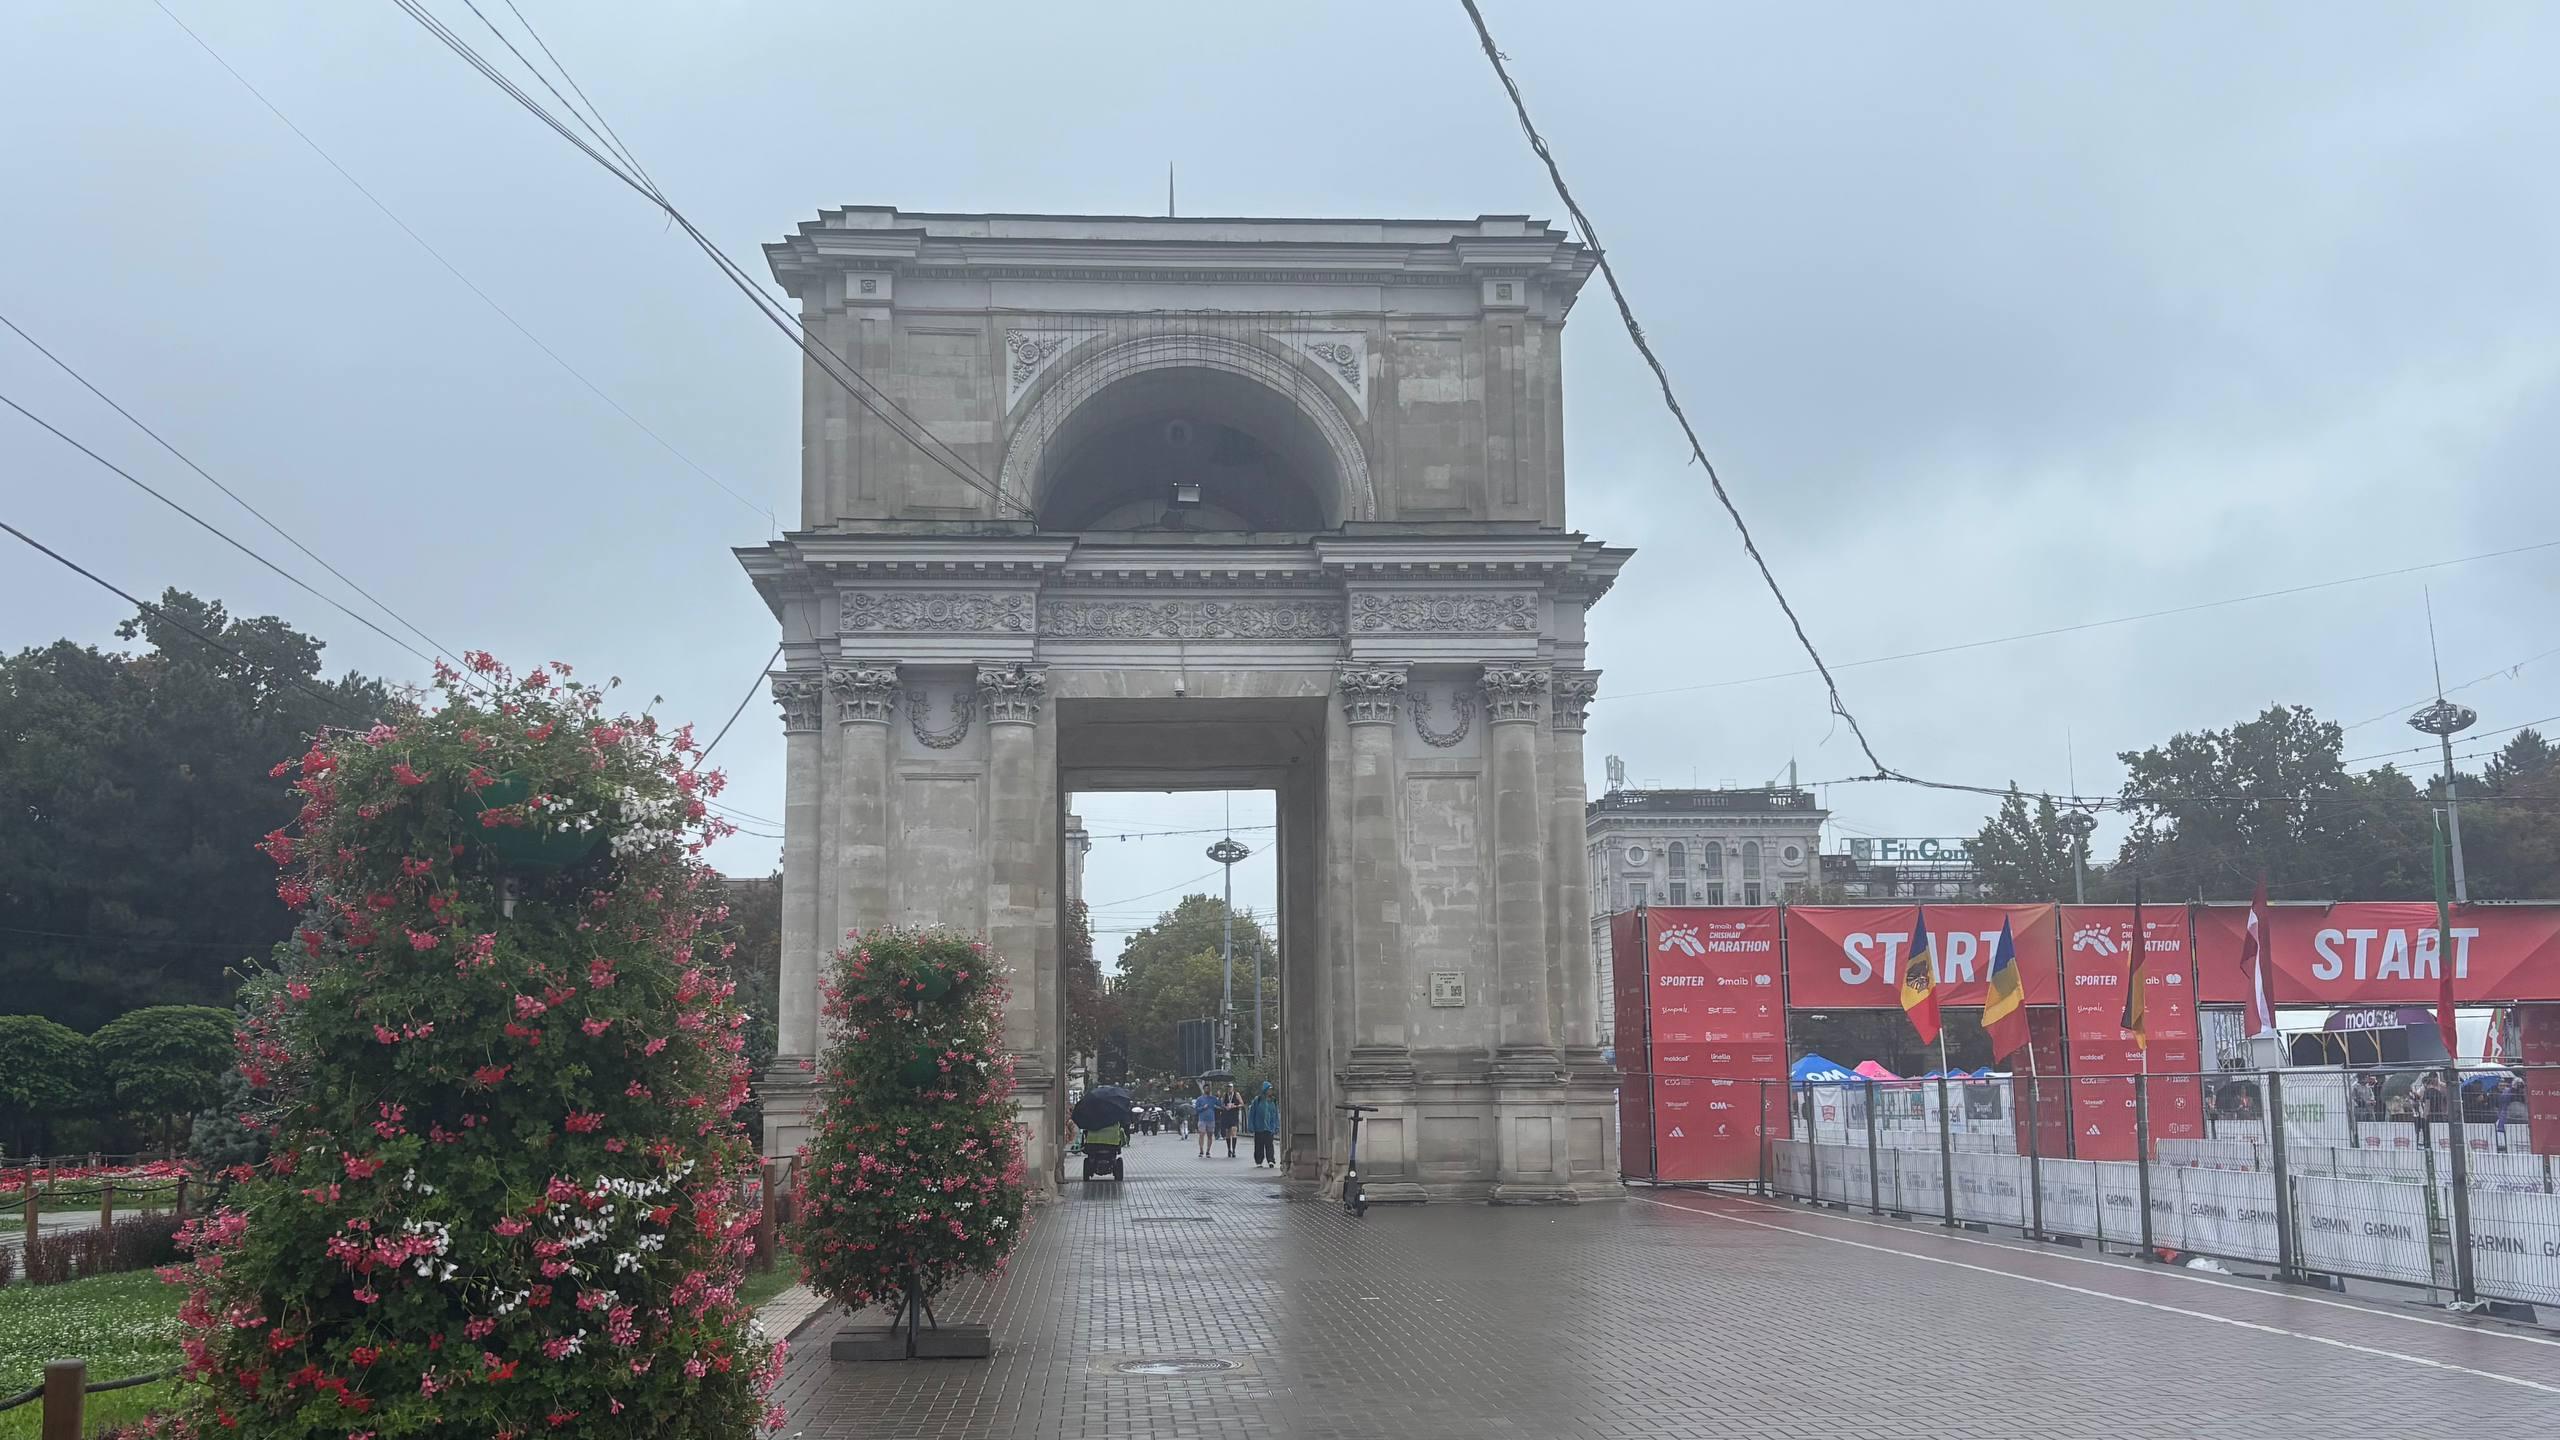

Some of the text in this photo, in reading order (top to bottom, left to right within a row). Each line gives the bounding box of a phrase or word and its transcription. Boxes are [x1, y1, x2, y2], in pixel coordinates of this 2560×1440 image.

[1708, 940, 1770, 952] MARATHON
[2120, 940, 2180, 952] MATHON
[2311, 927, 2479, 981] START
[1660, 975, 1705, 987] SPORTER
[1725, 976, 1749, 986] maib
[2075, 975, 2118, 986] SPORTER
[2145, 976, 2160, 985] aib
[1806, 1069, 1849, 1081] OM
[1709, 1101, 1728, 1110] OM
[2151, 1199, 2173, 1213] RMIN
[2190, 1203, 2228, 1219] GARMIN
[2237, 1208, 2279, 1225] GARMIN
[2311, 1215, 2350, 1233] GARMIN
[2364, 1222, 2412, 1240] GARMIN
